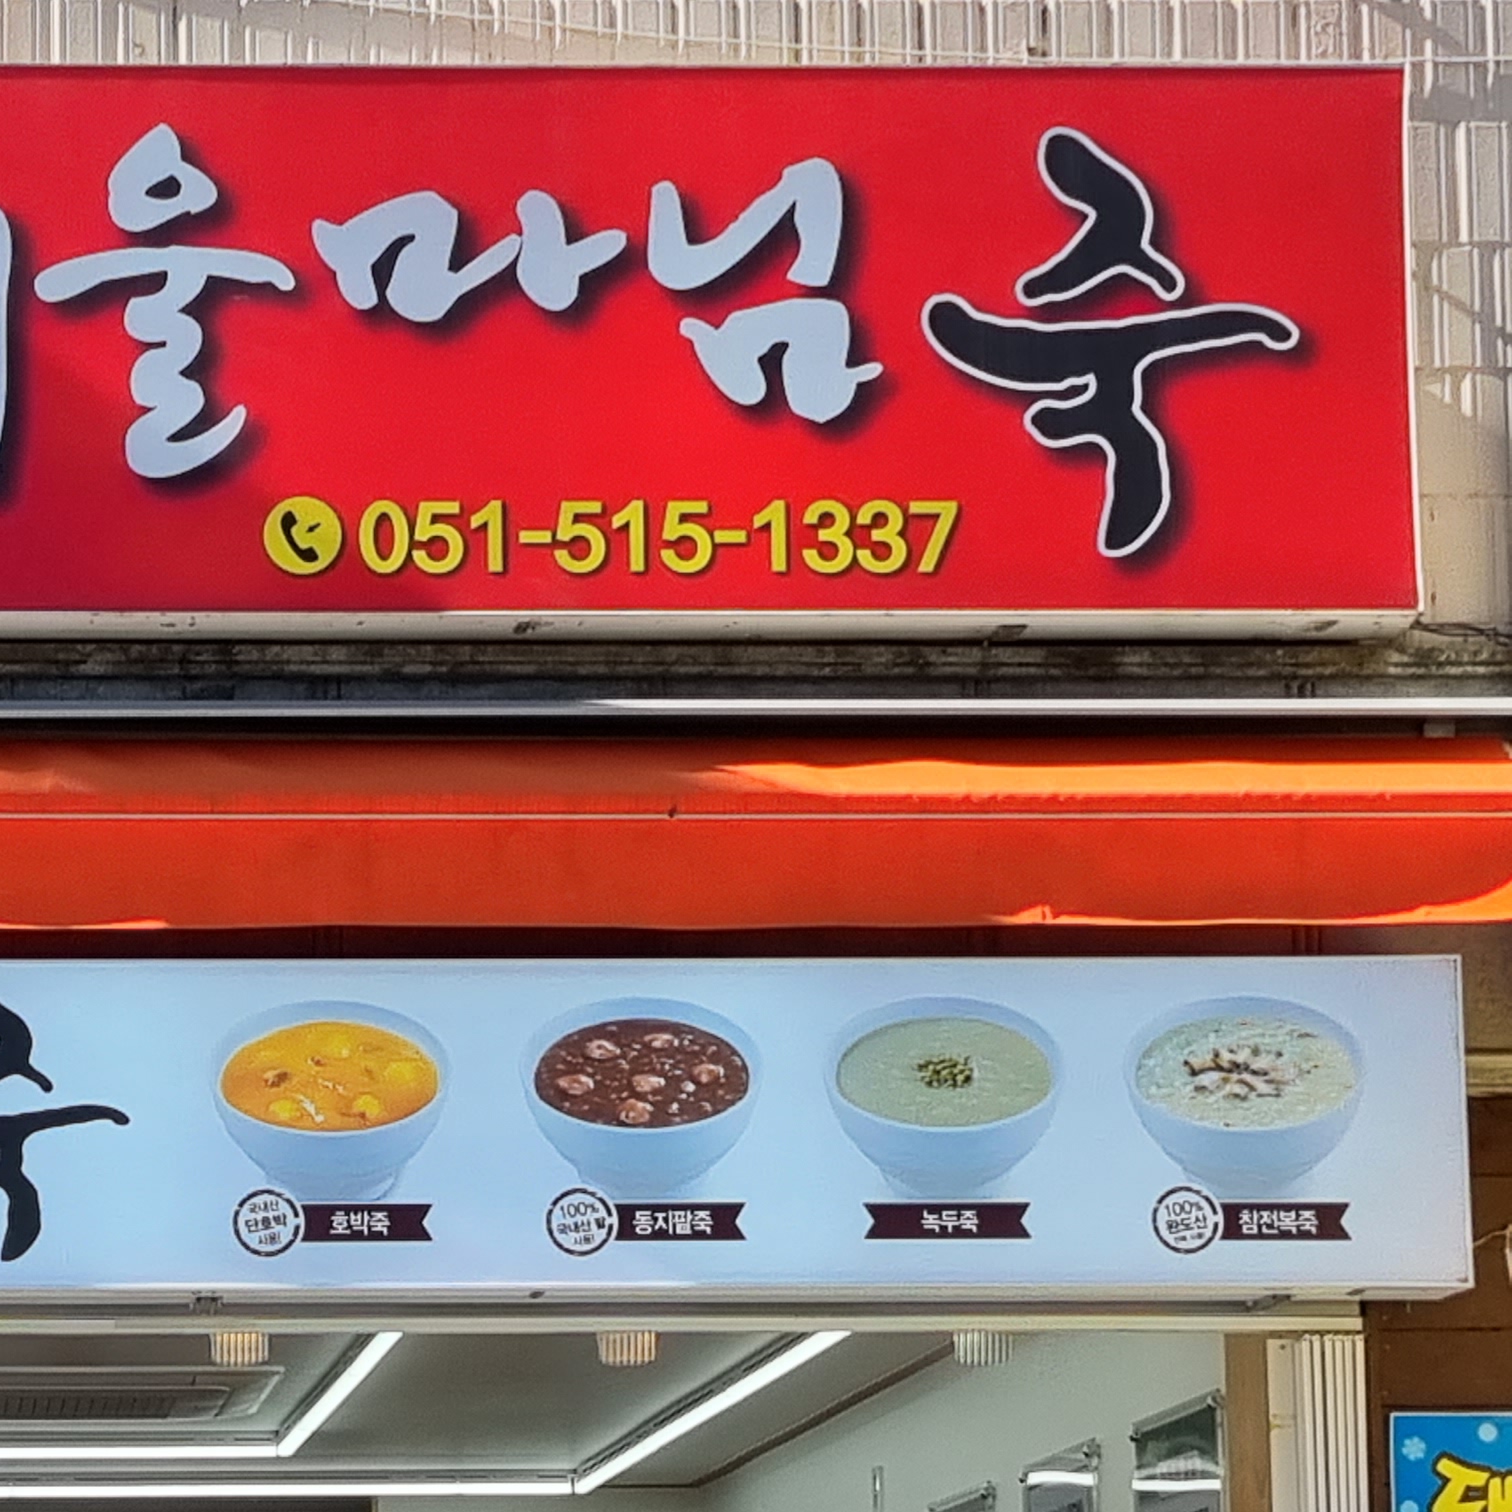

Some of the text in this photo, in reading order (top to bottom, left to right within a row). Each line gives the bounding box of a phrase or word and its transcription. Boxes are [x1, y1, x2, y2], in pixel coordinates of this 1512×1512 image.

[358, 498, 961, 577] 051-515-1337
[248, 1200, 279, 1214] 국내산
[560, 1202, 599, 1219] 100%
[1164, 1201, 1204, 1217] 100%
[245, 1213, 287, 1233] 단호박
[329, 1210, 391, 1236] 호박죽
[557, 1219, 591, 1235] 국내산
[632, 1210, 714, 1235] 동지팥죽
[921, 1210, 978, 1234] 녹두죽
[1165, 1213, 1208, 1234] 완도산
